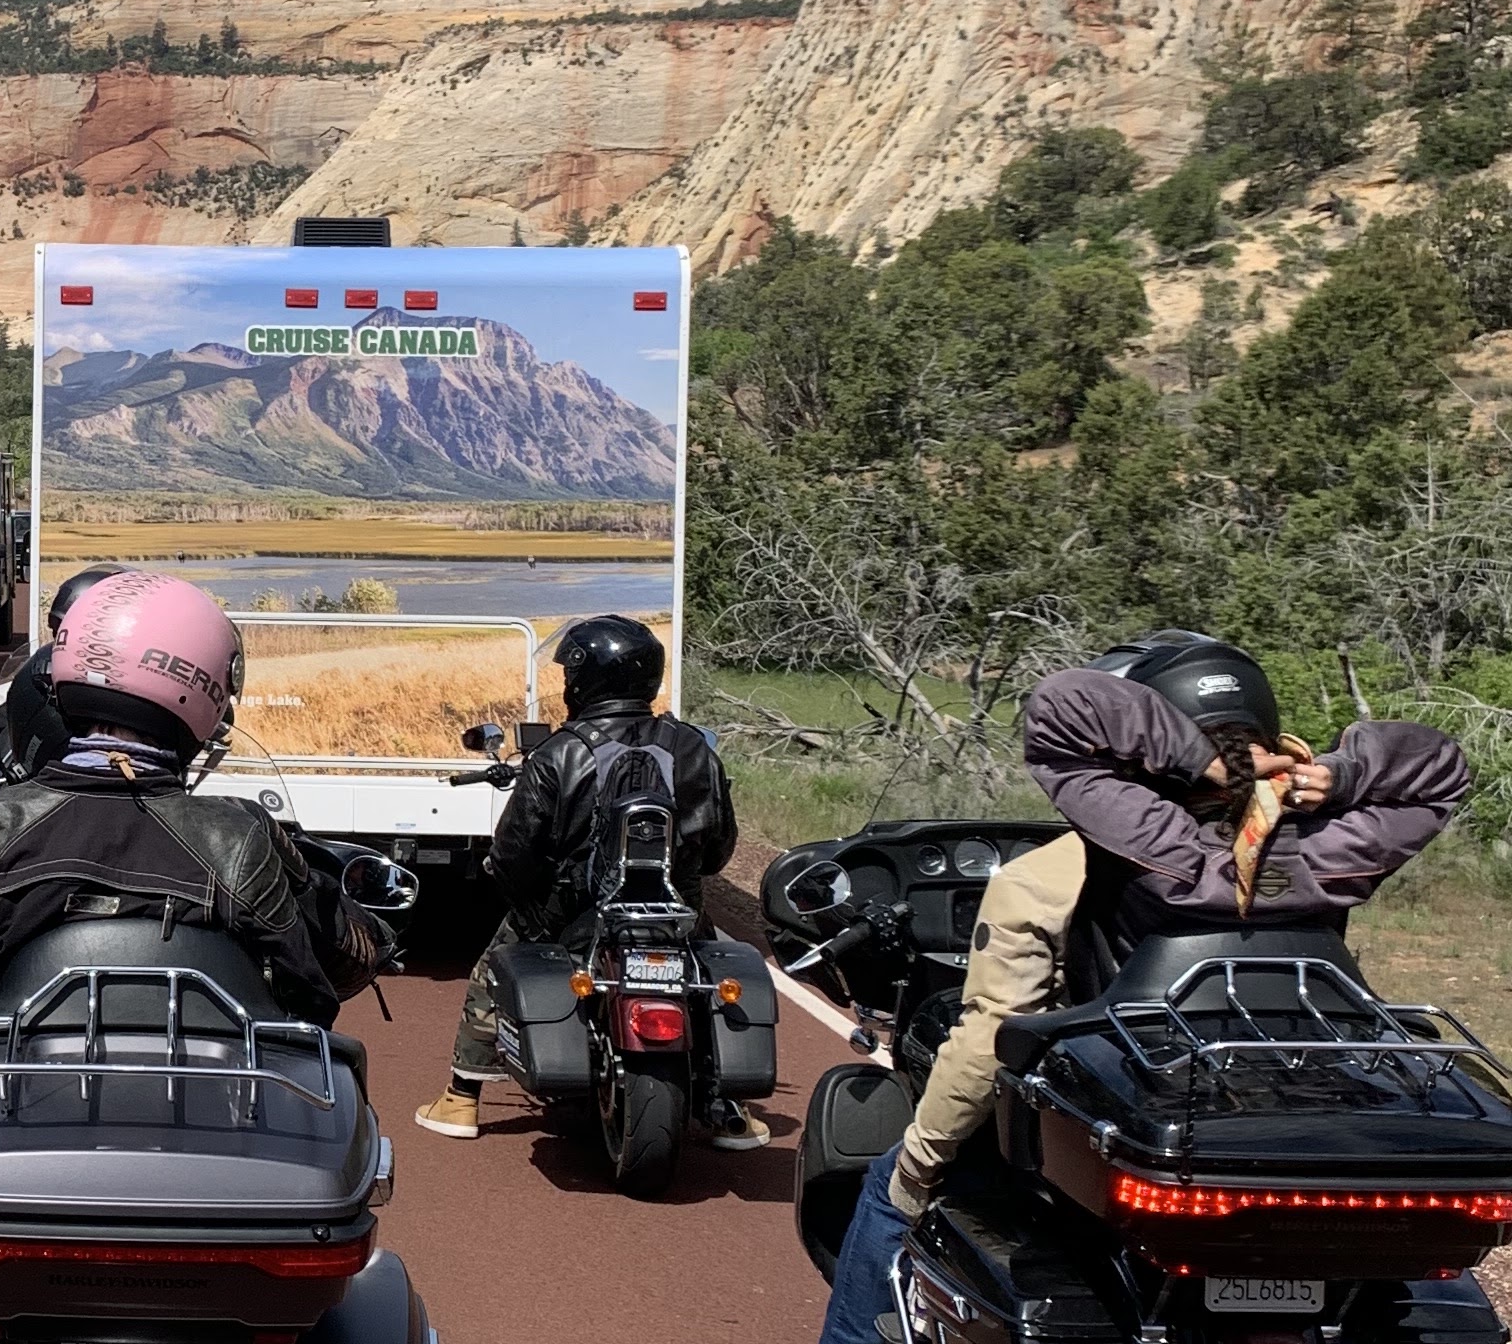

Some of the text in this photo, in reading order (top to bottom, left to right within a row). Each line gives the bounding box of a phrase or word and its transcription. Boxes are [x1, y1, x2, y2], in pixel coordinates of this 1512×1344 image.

[247, 327, 478, 355] CRUISE CANADA
[1218, 1279, 1312, 1301] 25L6815
